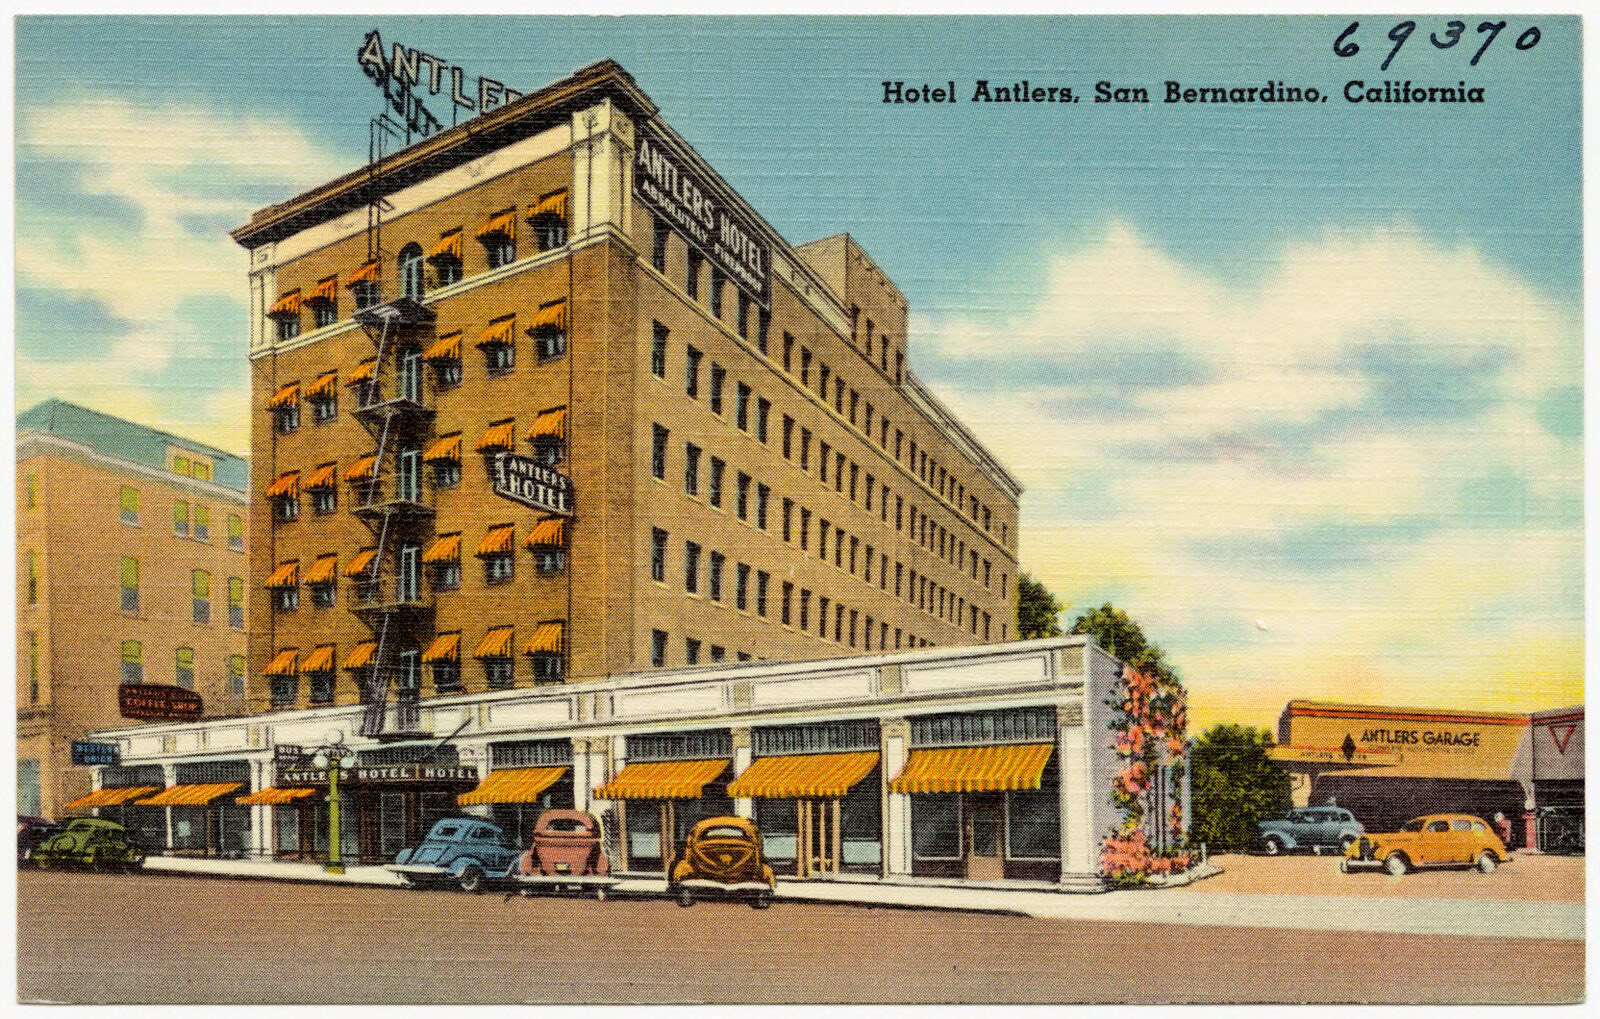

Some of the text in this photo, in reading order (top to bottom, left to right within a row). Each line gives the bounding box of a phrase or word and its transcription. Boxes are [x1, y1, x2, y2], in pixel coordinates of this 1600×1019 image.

[1333, 21, 1541, 71] 69370
[639, 138, 765, 279] ANTLERS HOTEL
[509, 458, 566, 490] ANTLERS
[510, 474, 567, 512] HOTEL
[1360, 729, 1480, 747] ANTLERS GARAGE
[282, 767, 475, 782] ANTLES HOTEL HOTEL
